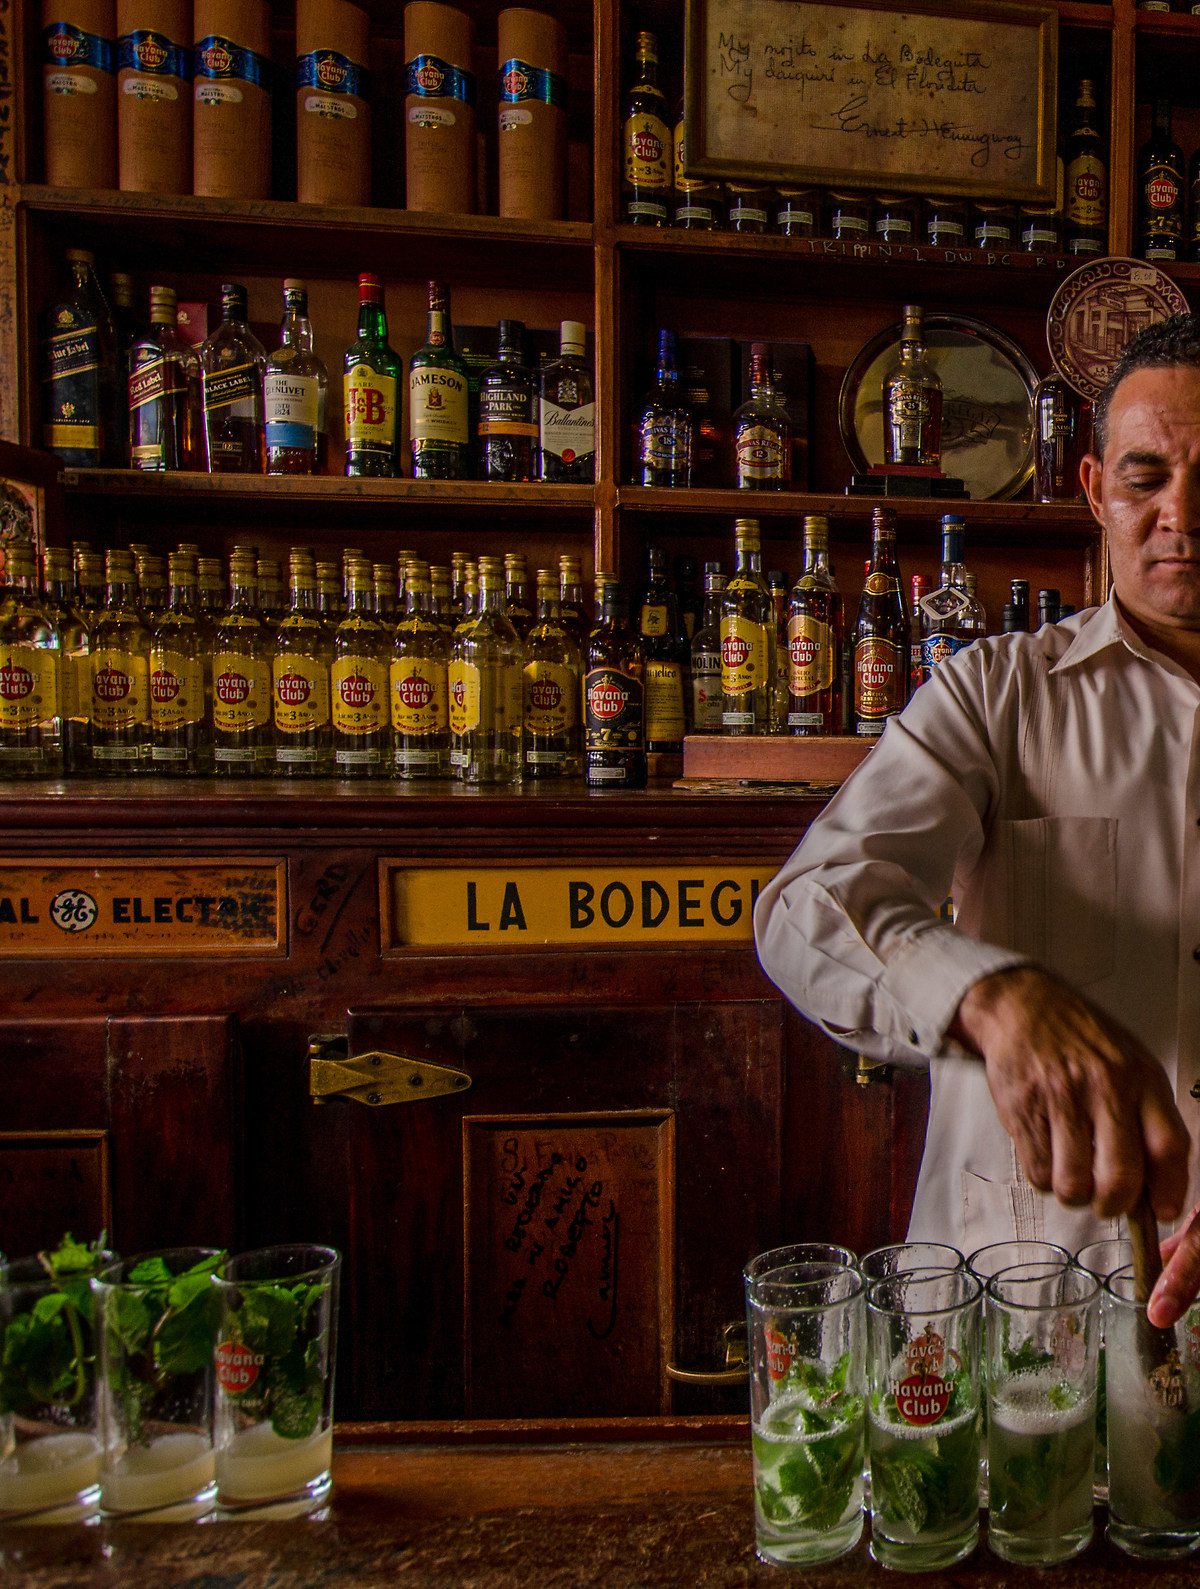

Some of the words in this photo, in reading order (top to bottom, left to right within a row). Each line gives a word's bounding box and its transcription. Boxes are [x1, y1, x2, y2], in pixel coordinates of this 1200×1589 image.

[53, 46, 72, 55] Club
[133, 45, 168, 58] Havana
[718, 33, 750, 62] My
[765, 37, 817, 68] mojito
[829, 46, 855, 62] in
[862, 41, 891, 64] La
[901, 43, 992, 77] Bodeguita
[139, 51, 161, 63] Club
[206, 57, 225, 68] Club
[315, 62, 348, 77] Havana
[415, 69, 445, 80] Havana
[321, 70, 341, 83] Club
[419, 76, 438, 87] Club
[719, 55, 754, 101] My
[766, 61, 835, 101] daiquiri
[848, 76, 865, 86] in
[875, 64, 897, 88] El
[906, 66, 987, 95] Floridita
[506, 82, 522, 91] Club
[830, 95, 906, 138] Ernest
[919, 117, 1035, 167] Hemingway
[635, 146, 658, 158] Club
[645, 166, 652, 175] 3
[1078, 186, 1098, 197] Club
[1144, 184, 1179, 195] Havana
[1151, 192, 1172, 204] Club
[1157, 216, 1165, 227] 7
[66, 341, 90, 358] Label
[142, 373, 162, 390] Label
[227, 374, 253, 389] LABEL
[411, 374, 464, 392] JAMESON
[266, 386, 305, 397] GLENLIVET
[480, 391, 528, 402] HIGHLAND
[347, 388, 386, 425] J&B
[488, 402, 513, 411] PARK
[906, 402, 917, 410] 25
[662, 436, 671, 445] 18
[723, 650, 744, 663] Club
[791, 650, 812, 662] Club
[857, 662, 894, 673] Havana
[862, 672, 885, 684] Club
[0, 682, 28, 695] Club
[98, 684, 124, 697] Club
[152, 687, 175, 698] Club
[219, 687, 245, 700] Club
[588, 688, 629, 700] Havana
[280, 689, 305, 701] Club
[343, 691, 370, 703] Club
[402, 692, 428, 703] Club
[533, 694, 557, 705] Club
[10, 706, 17, 715] 3
[107, 706, 115, 717] 3
[593, 700, 619, 712] Club
[228, 710, 235, 720] 3
[289, 711, 297, 721] 3
[353, 713, 361, 723] 3
[412, 713, 420, 723] 3
[600, 728, 611, 740] 7
[467, 881, 527, 931] LA
[218, 1367, 250, 1385] Club
[891, 1380, 954, 1398] Havana
[902, 1400, 941, 1416] Club
